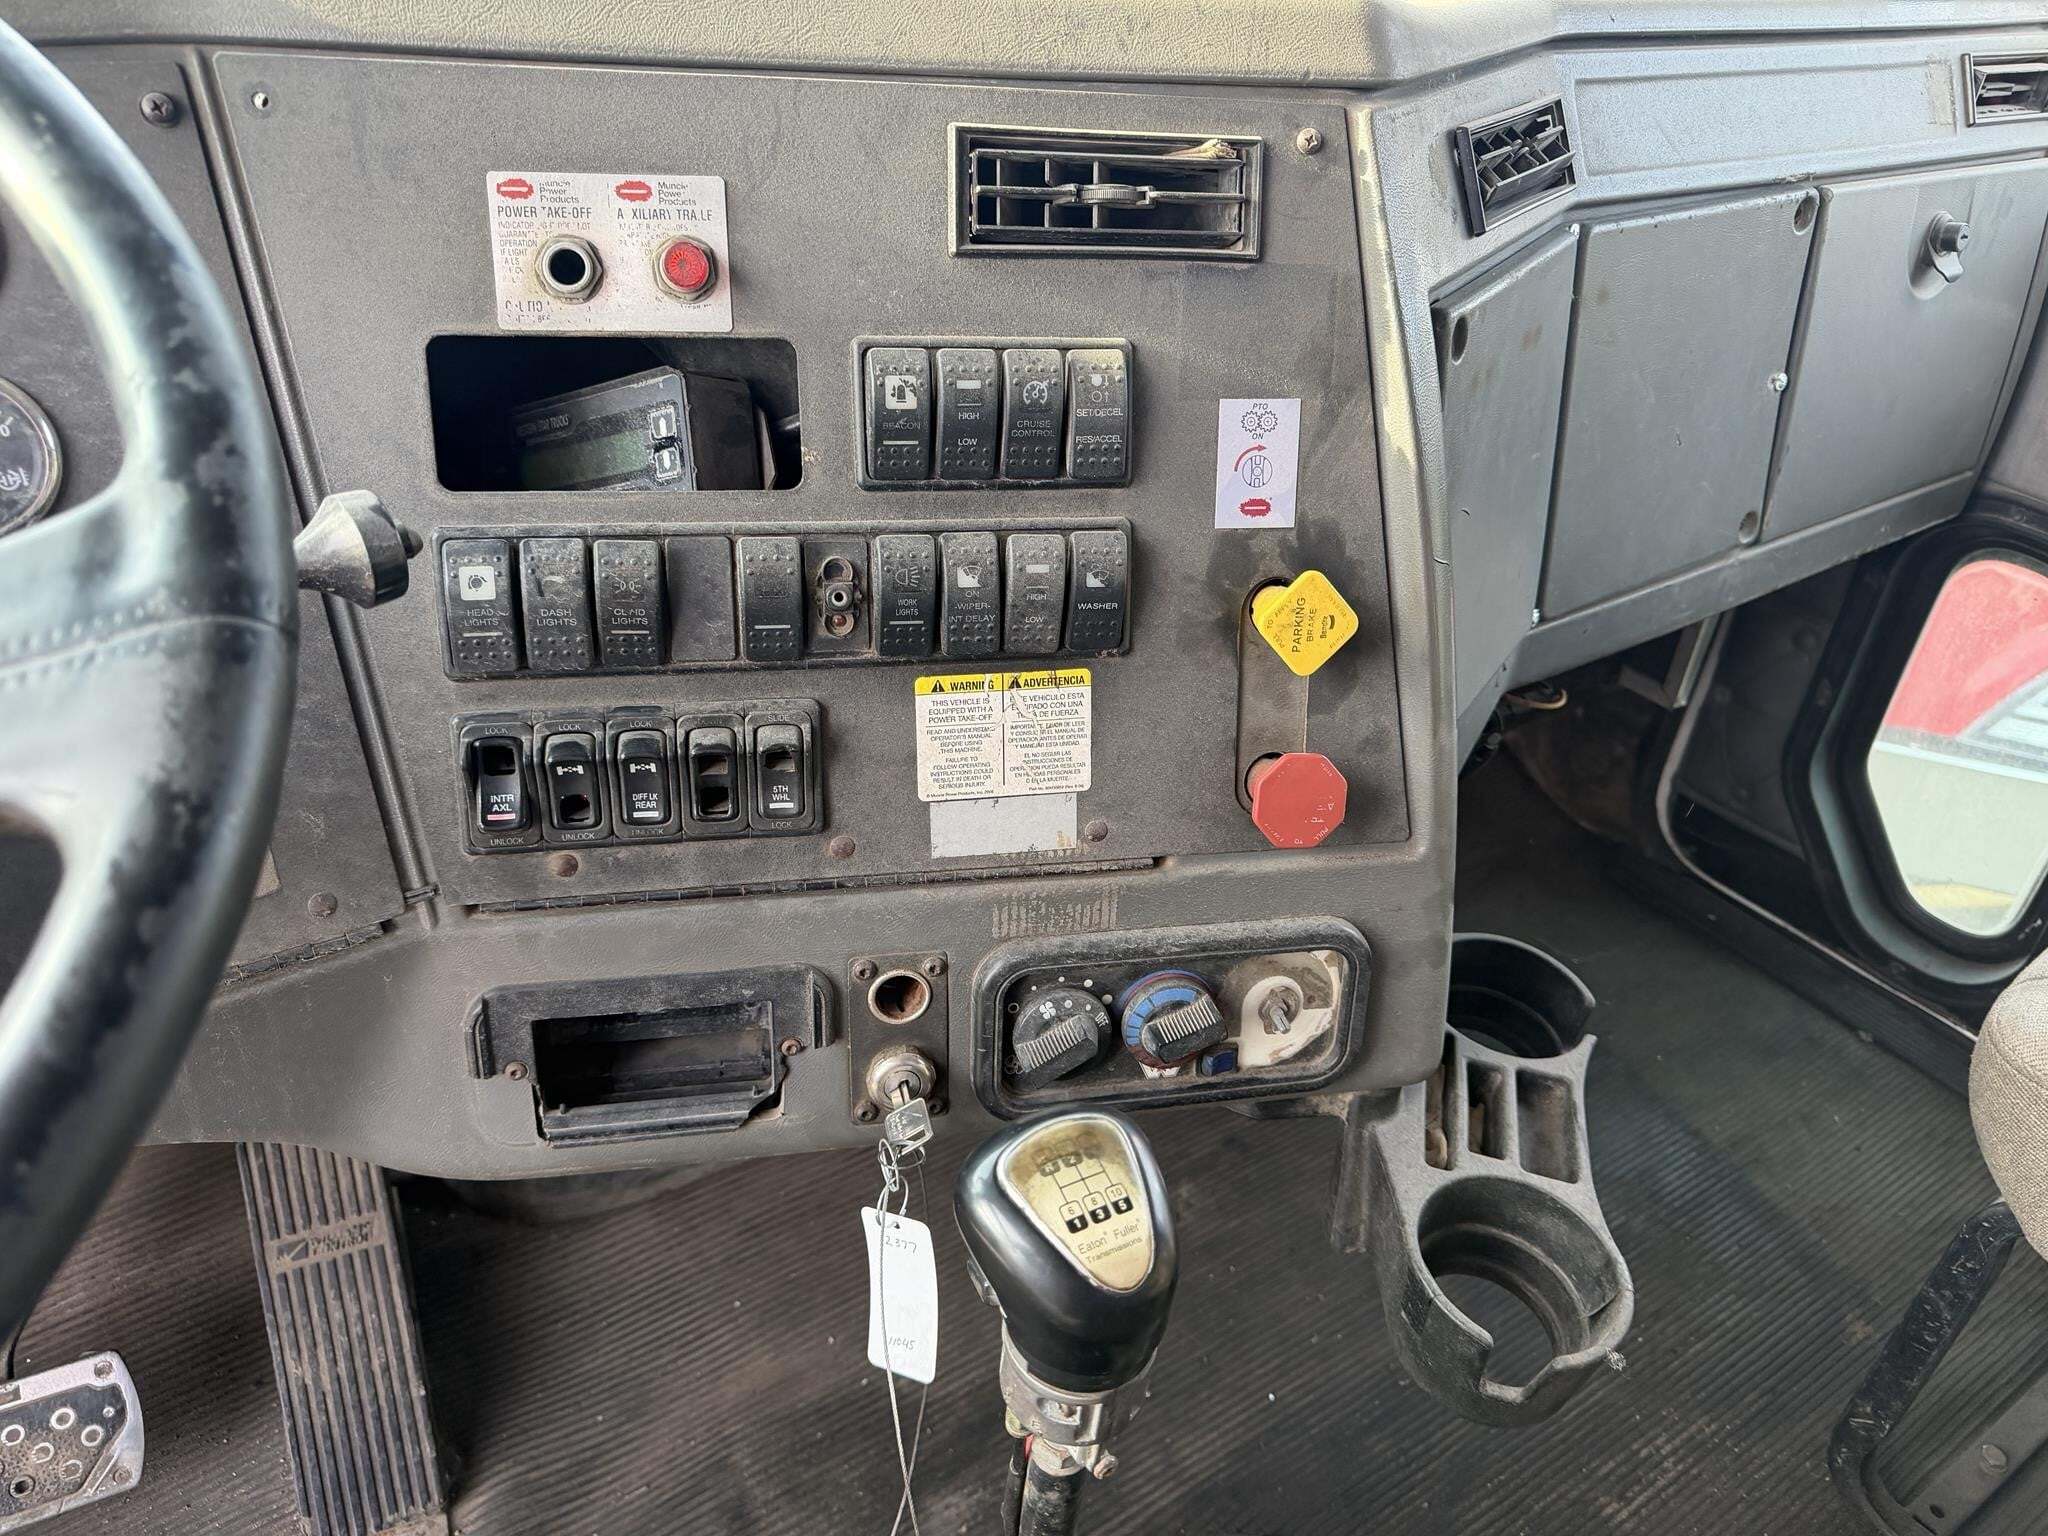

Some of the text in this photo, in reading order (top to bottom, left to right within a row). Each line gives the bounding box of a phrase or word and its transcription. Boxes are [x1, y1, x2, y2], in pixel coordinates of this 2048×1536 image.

[497, 206, 538, 218] POWER
[1252, 402, 1269, 411] PTO
[958, 411, 980, 421] HIGH
[1016, 419, 1051, 429] CRUISE
[1011, 428, 1055, 438] CONTROL
[1251, 432, 1264, 441] ON
[957, 437, 978, 446] LOW
[1075, 435, 1123, 444] RES/ACCEL
[1026, 593, 1047, 601] HIGH
[896, 599, 918, 608] WORK
[1077, 603, 1118, 611] WASHER
[467, 609, 494, 617] HEAD
[541, 608, 572, 617] DASH
[895, 607, 919, 617] LIGHTS
[464, 617, 499, 627] LIGHTS
[537, 617, 577, 627] LIGHTS
[611, 617, 649, 625] LIGHTS
[965, 614, 996, 622] DELAY
[1292, 597, 1306, 653] PARKING
[1306, 608, 1317, 643] BRAKE
[1023, 675, 1086, 688] ADVERTENCIA
[950, 698, 980, 706] VEHICLE
[1028, 693, 1066, 702] VEHICULO
[1067, 700, 1083, 708] UNA
[929, 707, 966, 716] EQUIPPED
[967, 706, 987, 714] WITH
[1040, 710, 1049, 718] DE
[1050, 708, 1079, 716] FUERZA
[768, 714, 790, 722] SLIDE
[929, 713, 993, 724] POWER TAKE-OFF
[558, 723, 582, 732] LOCK
[630, 719, 653, 728] LOCK
[485, 726, 508, 735] LOCK
[772, 785, 789, 793] 5TH
[490, 794, 514, 804] INTR
[632, 793, 658, 802] DIFF LK
[771, 793, 791, 801] WHL
[492, 803, 512, 812] AXL
[635, 801, 657, 809] REAR
[771, 821, 793, 829] LOCK
[490, 837, 524, 846] UNLOCK
[562, 833, 595, 842] UNLOCK
[1095, 1011, 1109, 1028] OFF
[1110, 1188, 1123, 1198] 10
[1073, 1200, 1127, 1229] 1 3 5
